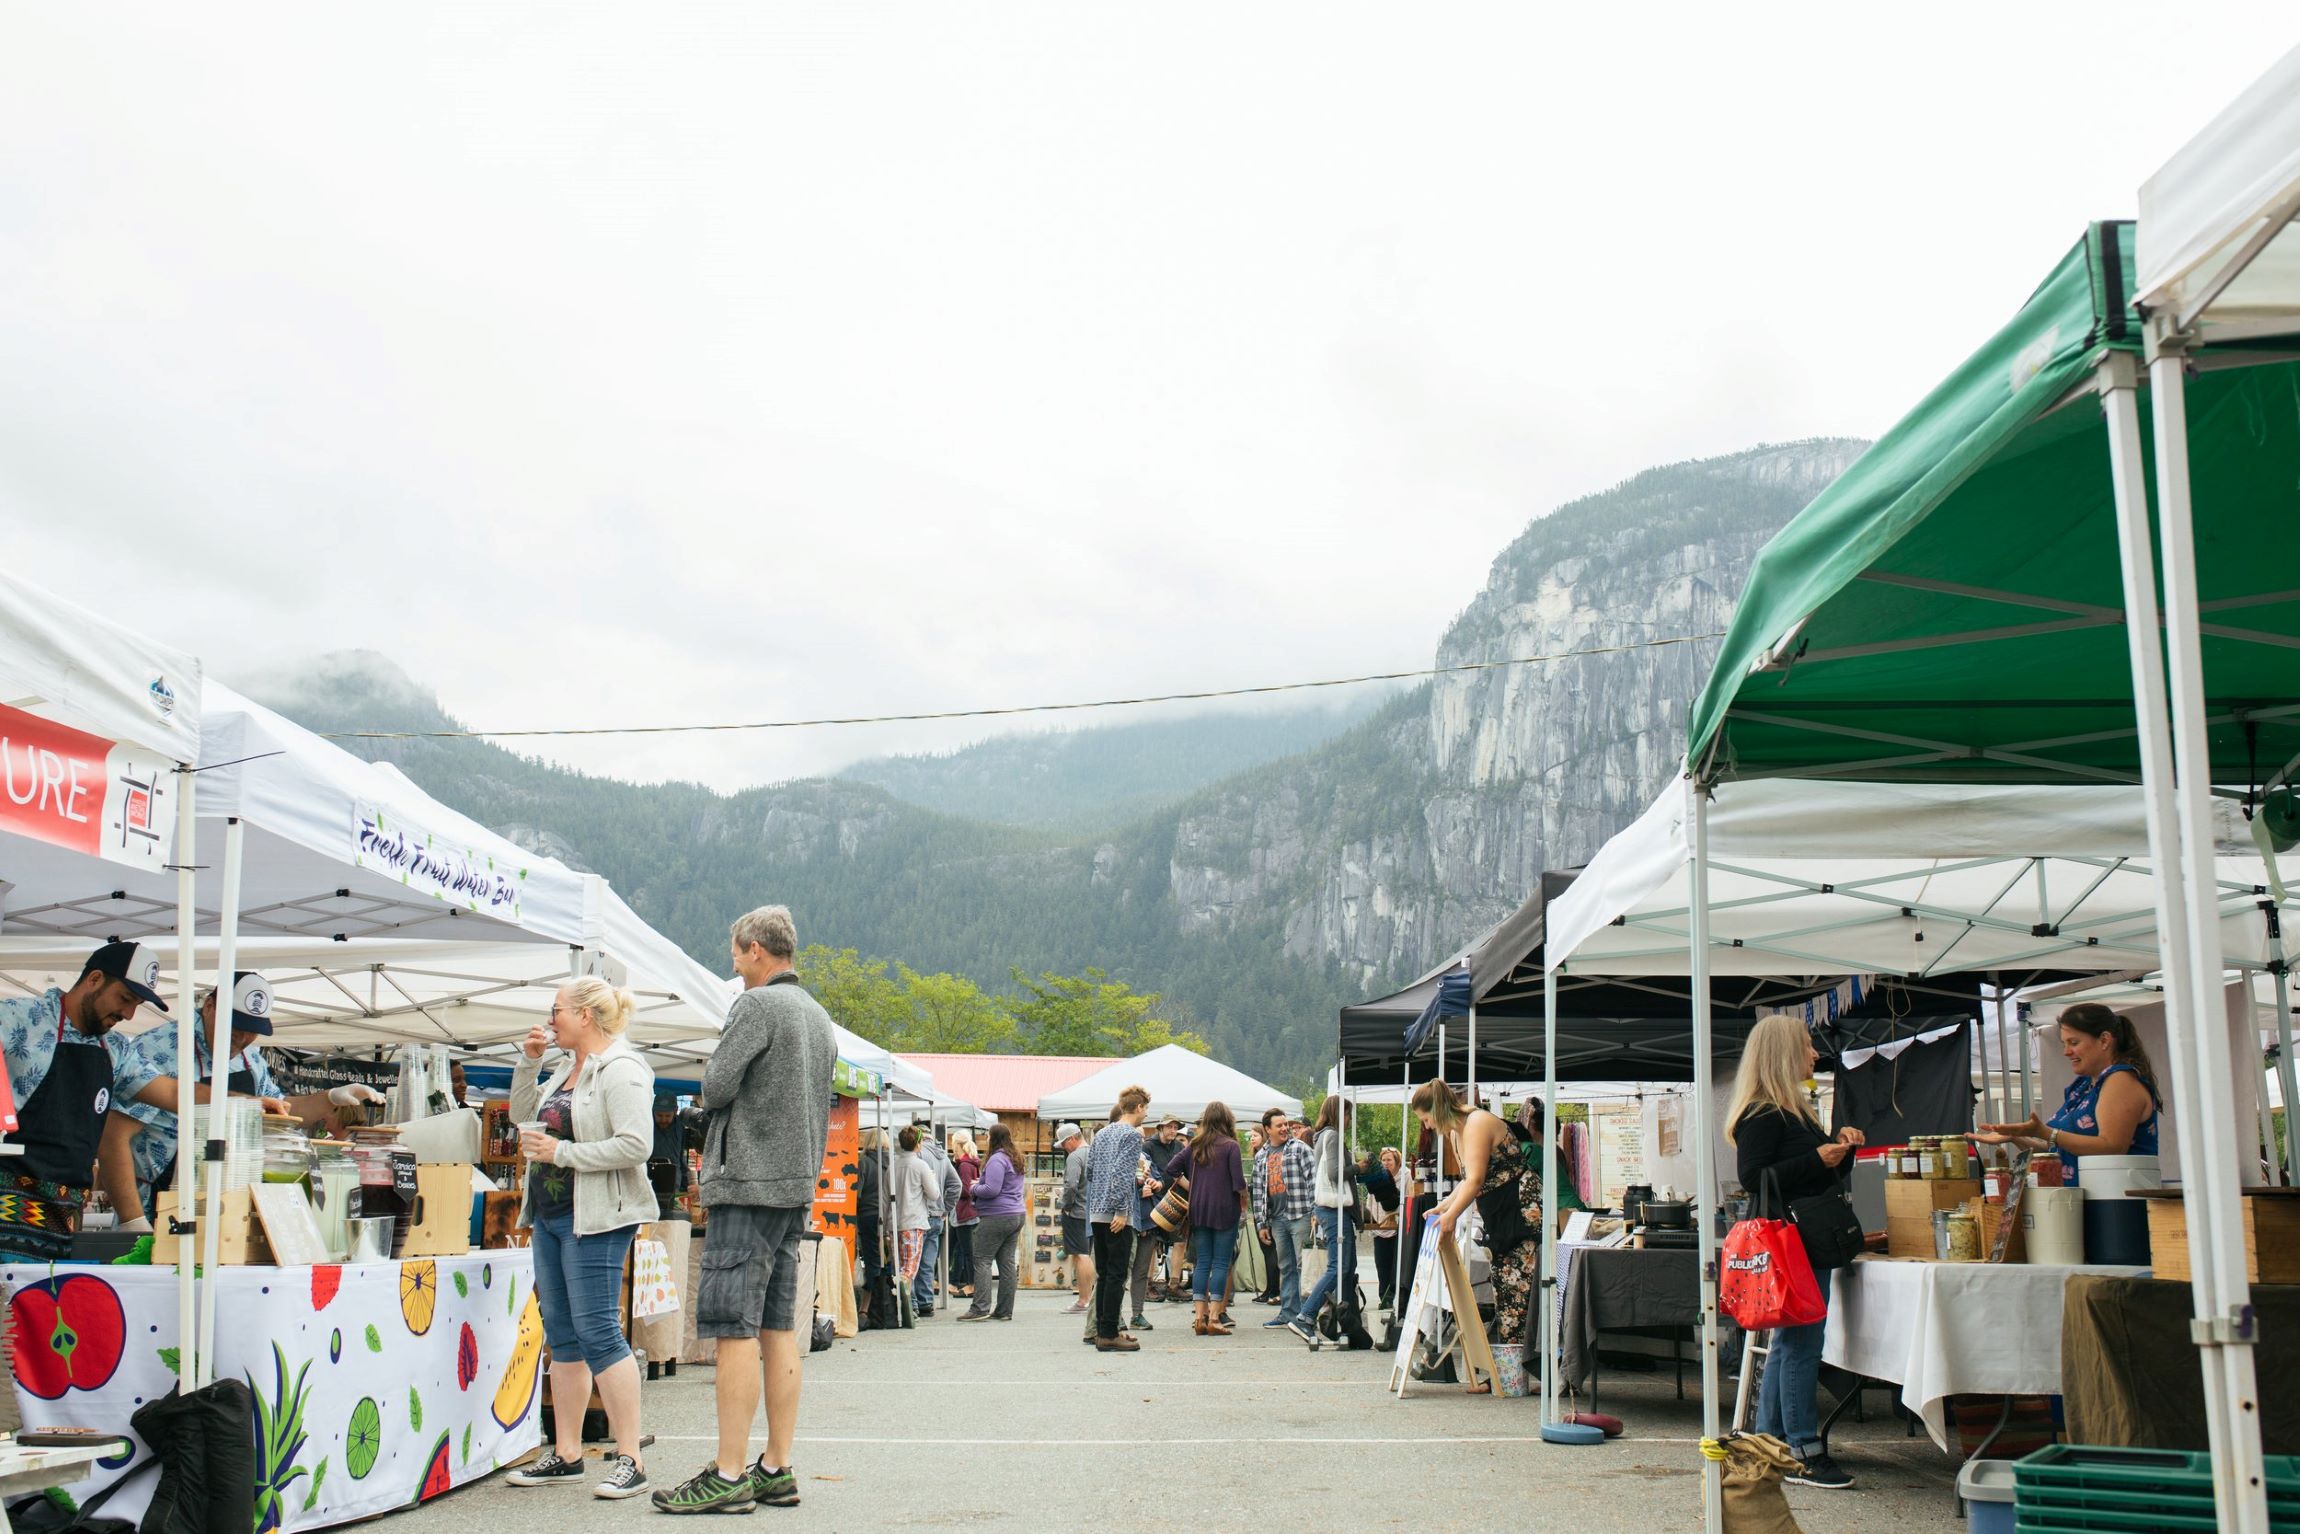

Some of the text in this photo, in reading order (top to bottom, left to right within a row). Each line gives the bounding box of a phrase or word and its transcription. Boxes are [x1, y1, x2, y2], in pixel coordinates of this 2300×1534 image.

[2, 736, 89, 823] URE
[360, 818, 409, 869] Fresh
[410, 842, 451, 888] Fruit
[452, 858, 492, 898] Water
[329, 1069, 347, 1081] Glass
